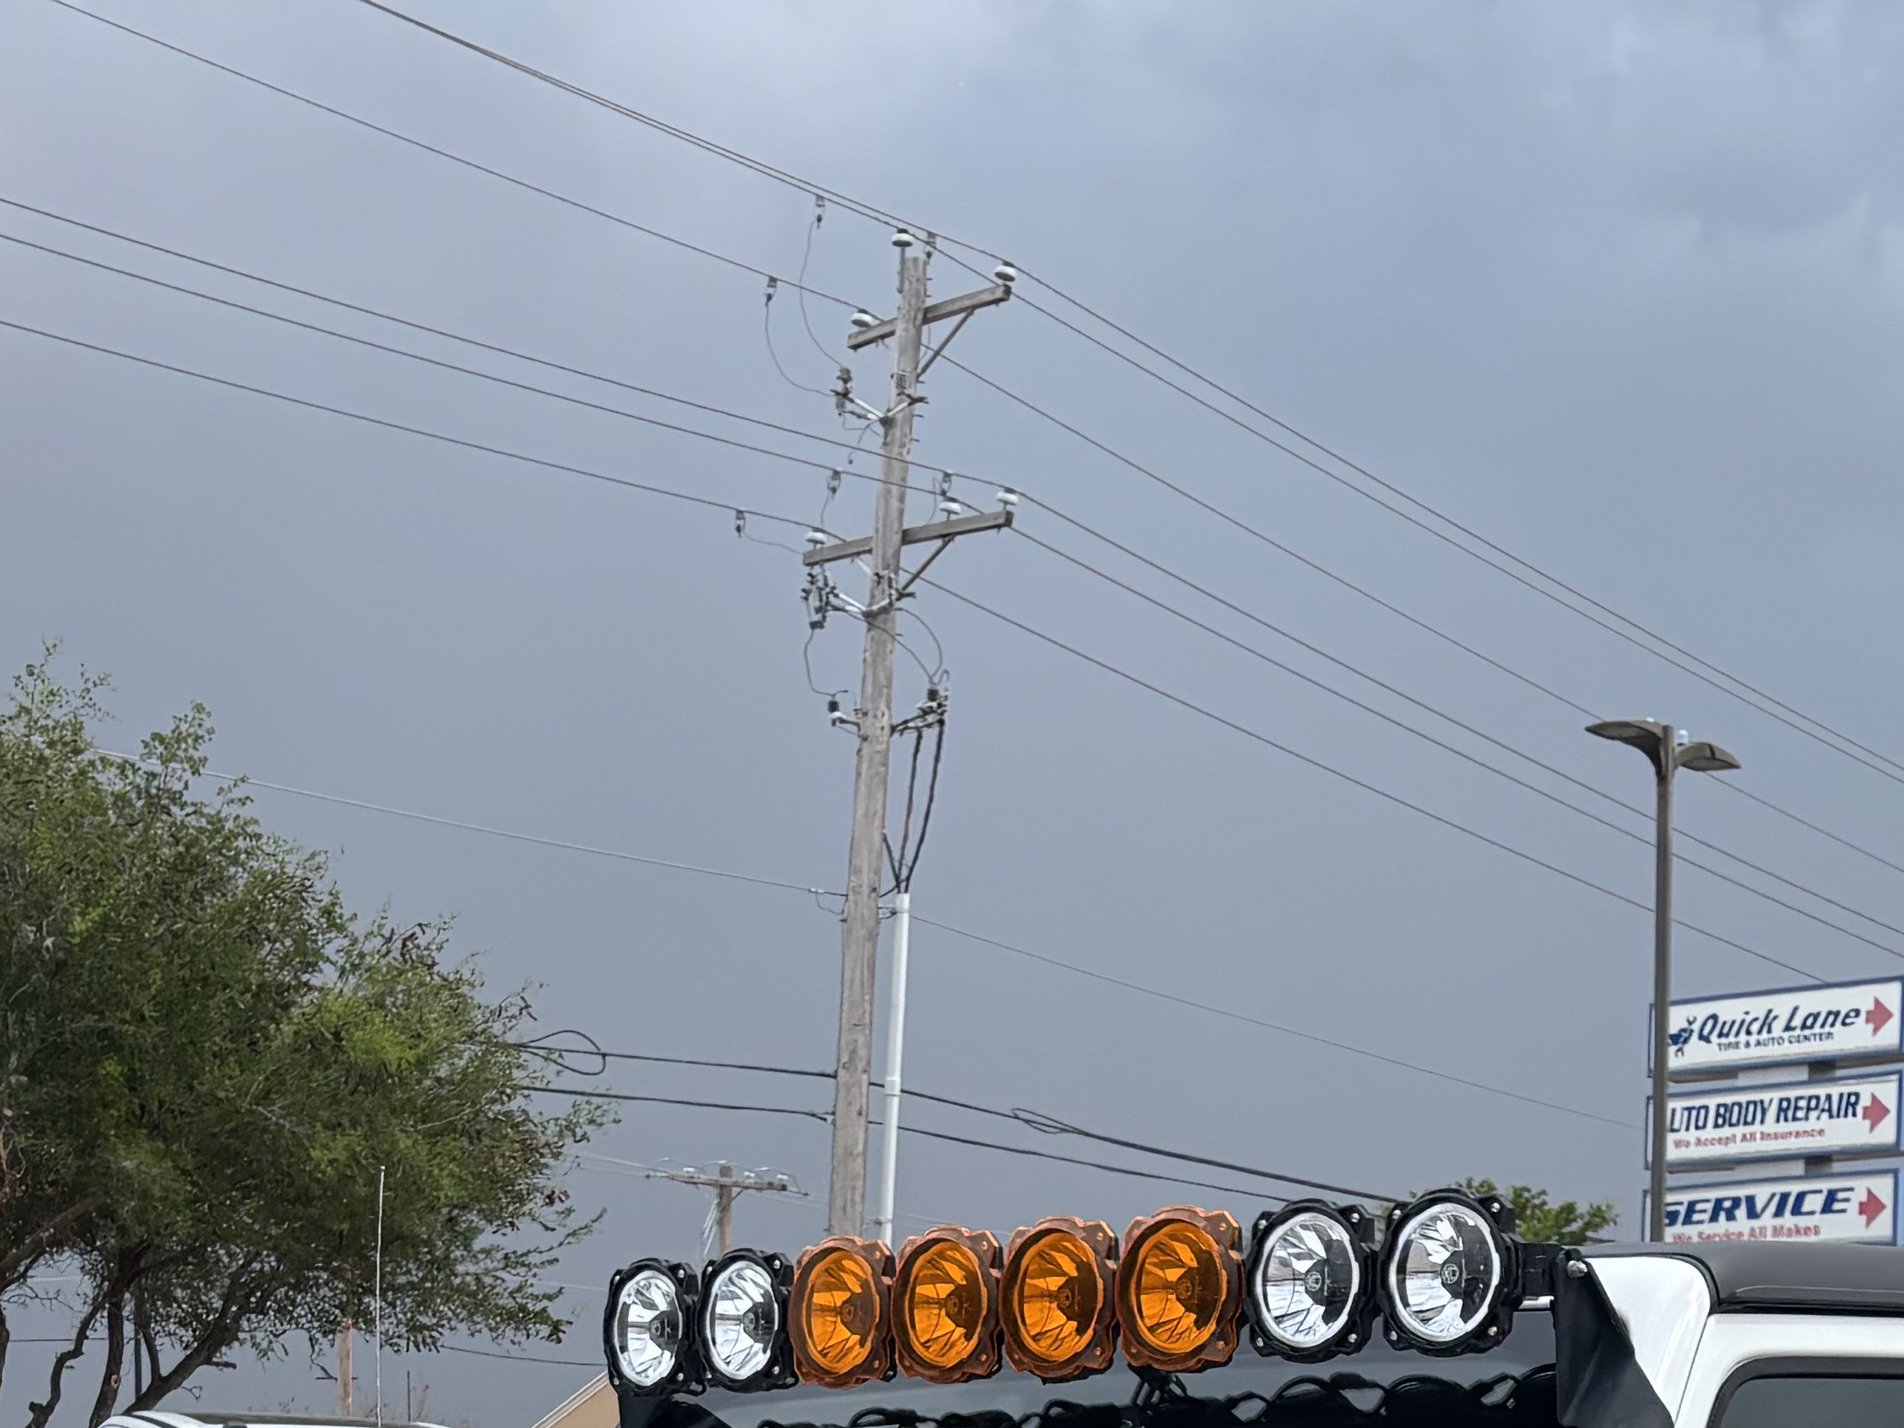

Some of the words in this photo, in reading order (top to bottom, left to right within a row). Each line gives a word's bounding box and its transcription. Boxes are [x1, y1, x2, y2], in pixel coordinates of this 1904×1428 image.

[1697, 1008, 1779, 1044] Quick
[1782, 1004, 1862, 1033] Lane
[1716, 1041, 1741, 1052] TIRE
[1754, 1036, 1786, 1048] AUTO
[1788, 1032, 1835, 1045] CENTER
[1669, 1105, 1709, 1133] UTO
[1713, 1098, 1774, 1130] BODY
[1776, 1092, 1862, 1125] REPAIR
[1673, 1138, 1692, 1149] We
[1695, 1133, 1738, 1147] Accept
[1760, 1127, 1826, 1142] Insurance
[1664, 1187, 1856, 1228] SERVICE
[1697, 1230, 1745, 1242] Service
[1771, 1223, 1822, 1237] Makes
